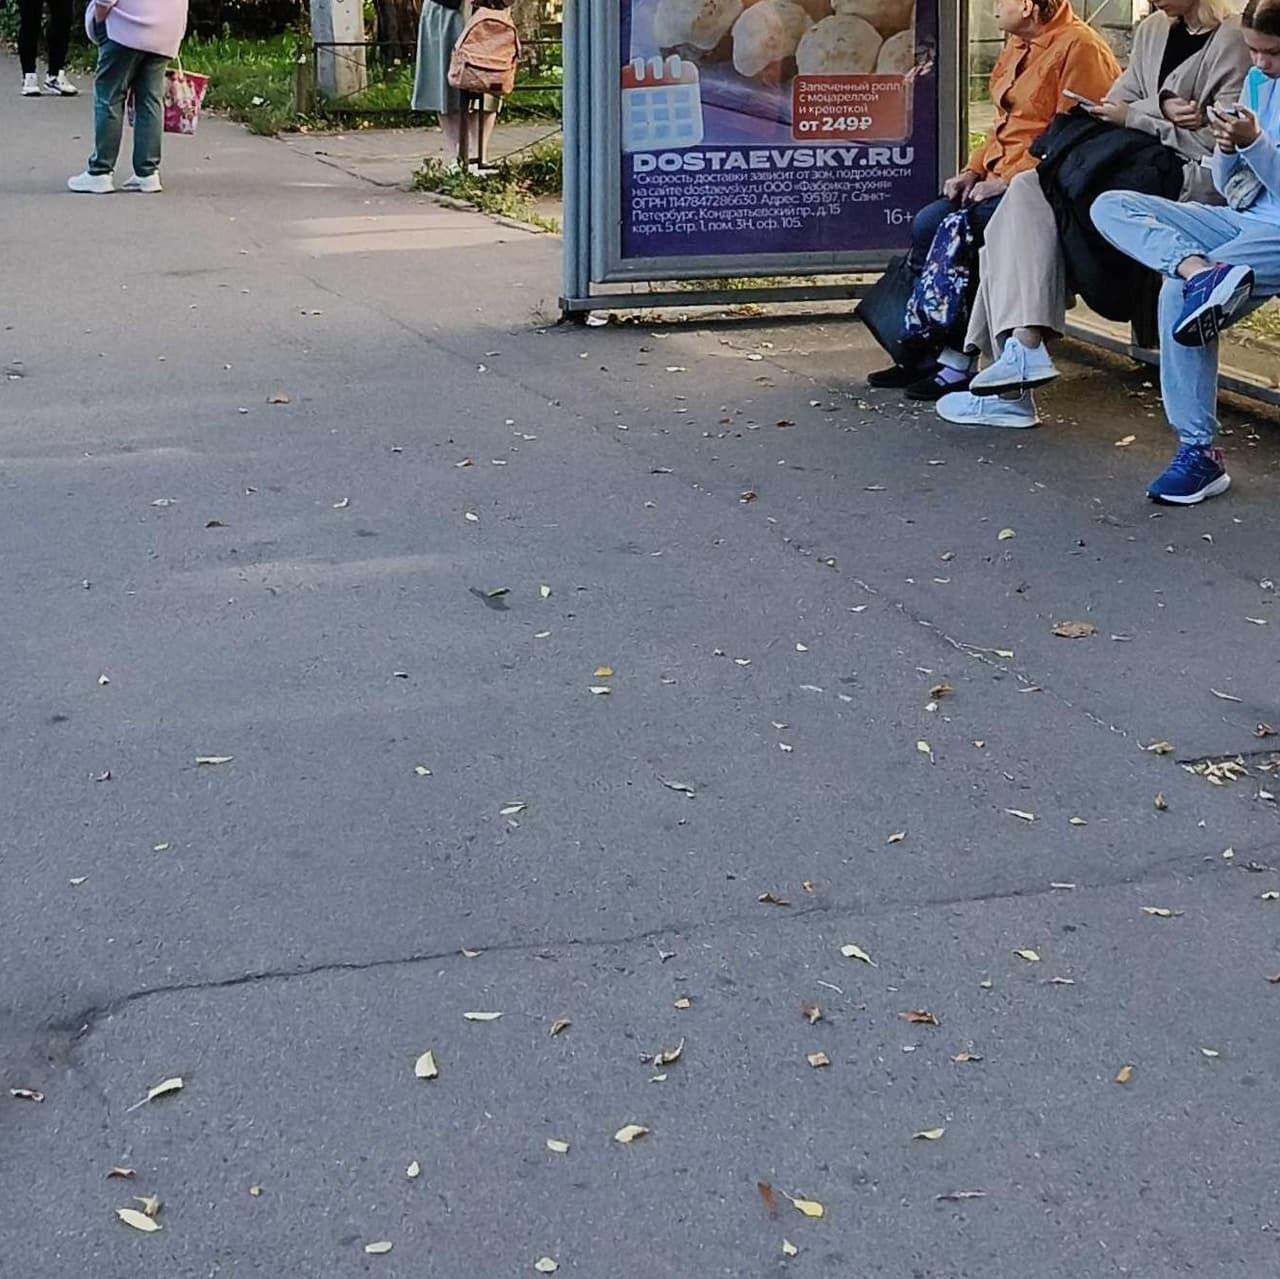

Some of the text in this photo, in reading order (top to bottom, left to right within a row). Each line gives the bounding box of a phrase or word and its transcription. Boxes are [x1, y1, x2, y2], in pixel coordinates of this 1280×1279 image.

[799, 81, 901, 94] Запеченный ролл
[799, 92, 879, 104] с моцареллой
[799, 106, 806, 114] и
[799, 116, 873, 132] от 249₽
[632, 147, 915, 173] DOSTAEVSKY.RU
[694, 172, 748, 184] доставки
[750, 171, 794, 181] зависит
[796, 170, 810, 180] от
[836, 167, 912, 180] подробности
[632, 187, 647, 197] на
[648, 185, 683, 196] сайте
[684, 183, 762, 196] dostaevsky.ru
[763, 181, 793, 192] ООО
[632, 197, 667, 209] ОГРН
[851, 191, 892, 202] Санкт-
[700, 205, 794, 220] Кондратьевский
[883, 208, 914, 225] 16+
[665, 221, 674, 232] 5
